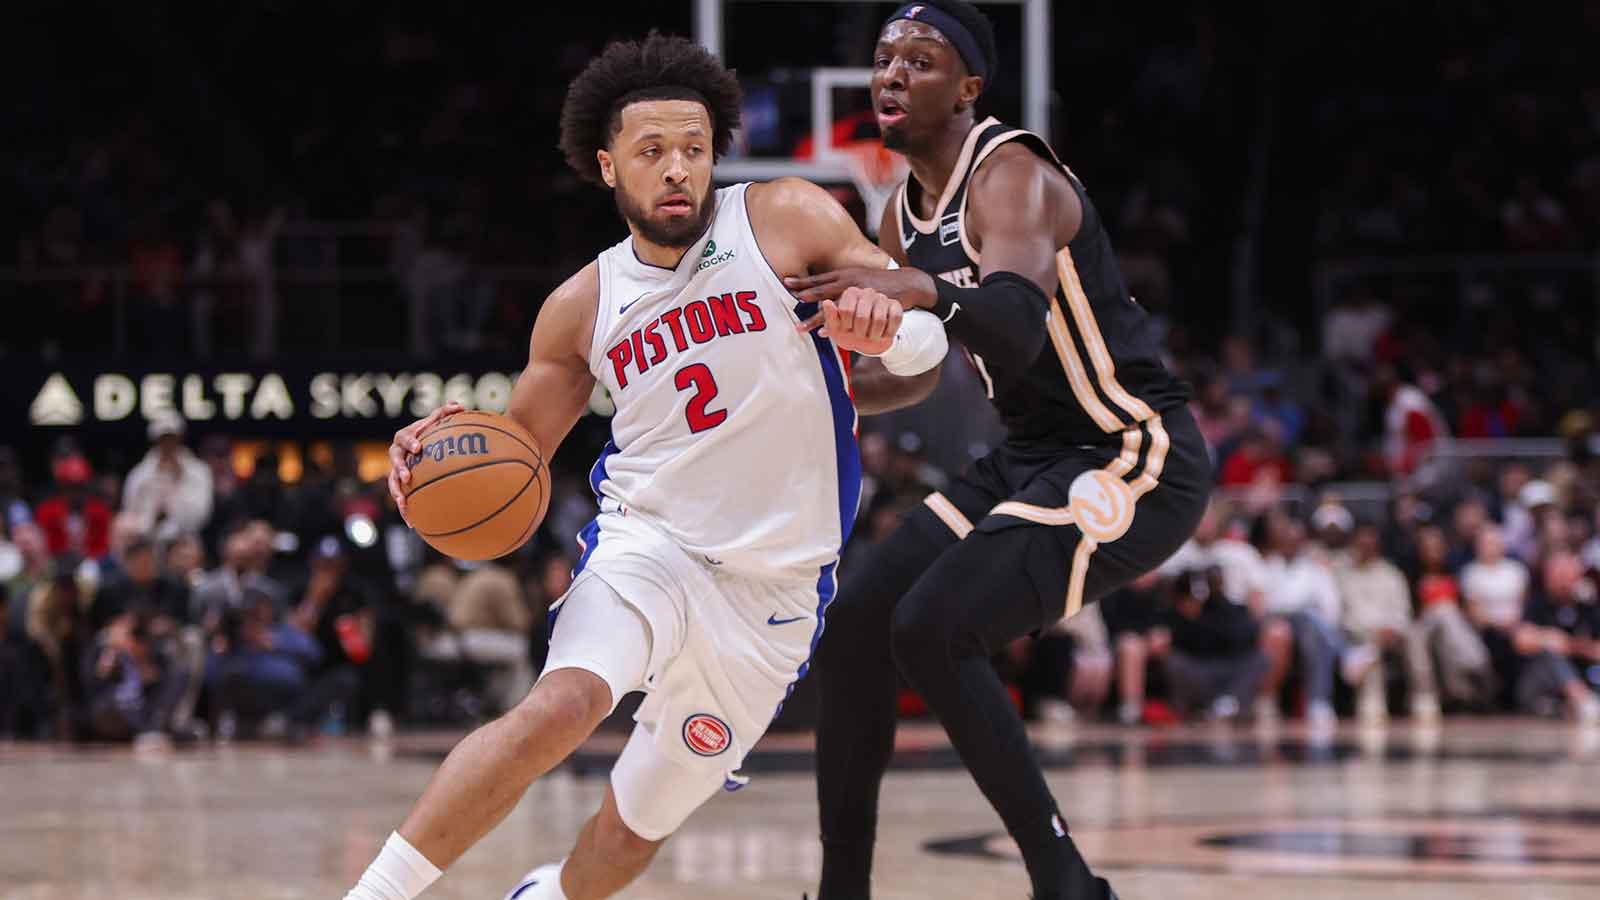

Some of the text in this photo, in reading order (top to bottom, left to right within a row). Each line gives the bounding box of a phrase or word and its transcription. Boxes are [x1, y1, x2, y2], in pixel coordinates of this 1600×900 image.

[606, 290, 767, 390] PISTONS
[93, 371, 519, 421] DELTA SKY360
[674, 363, 728, 434] 2
